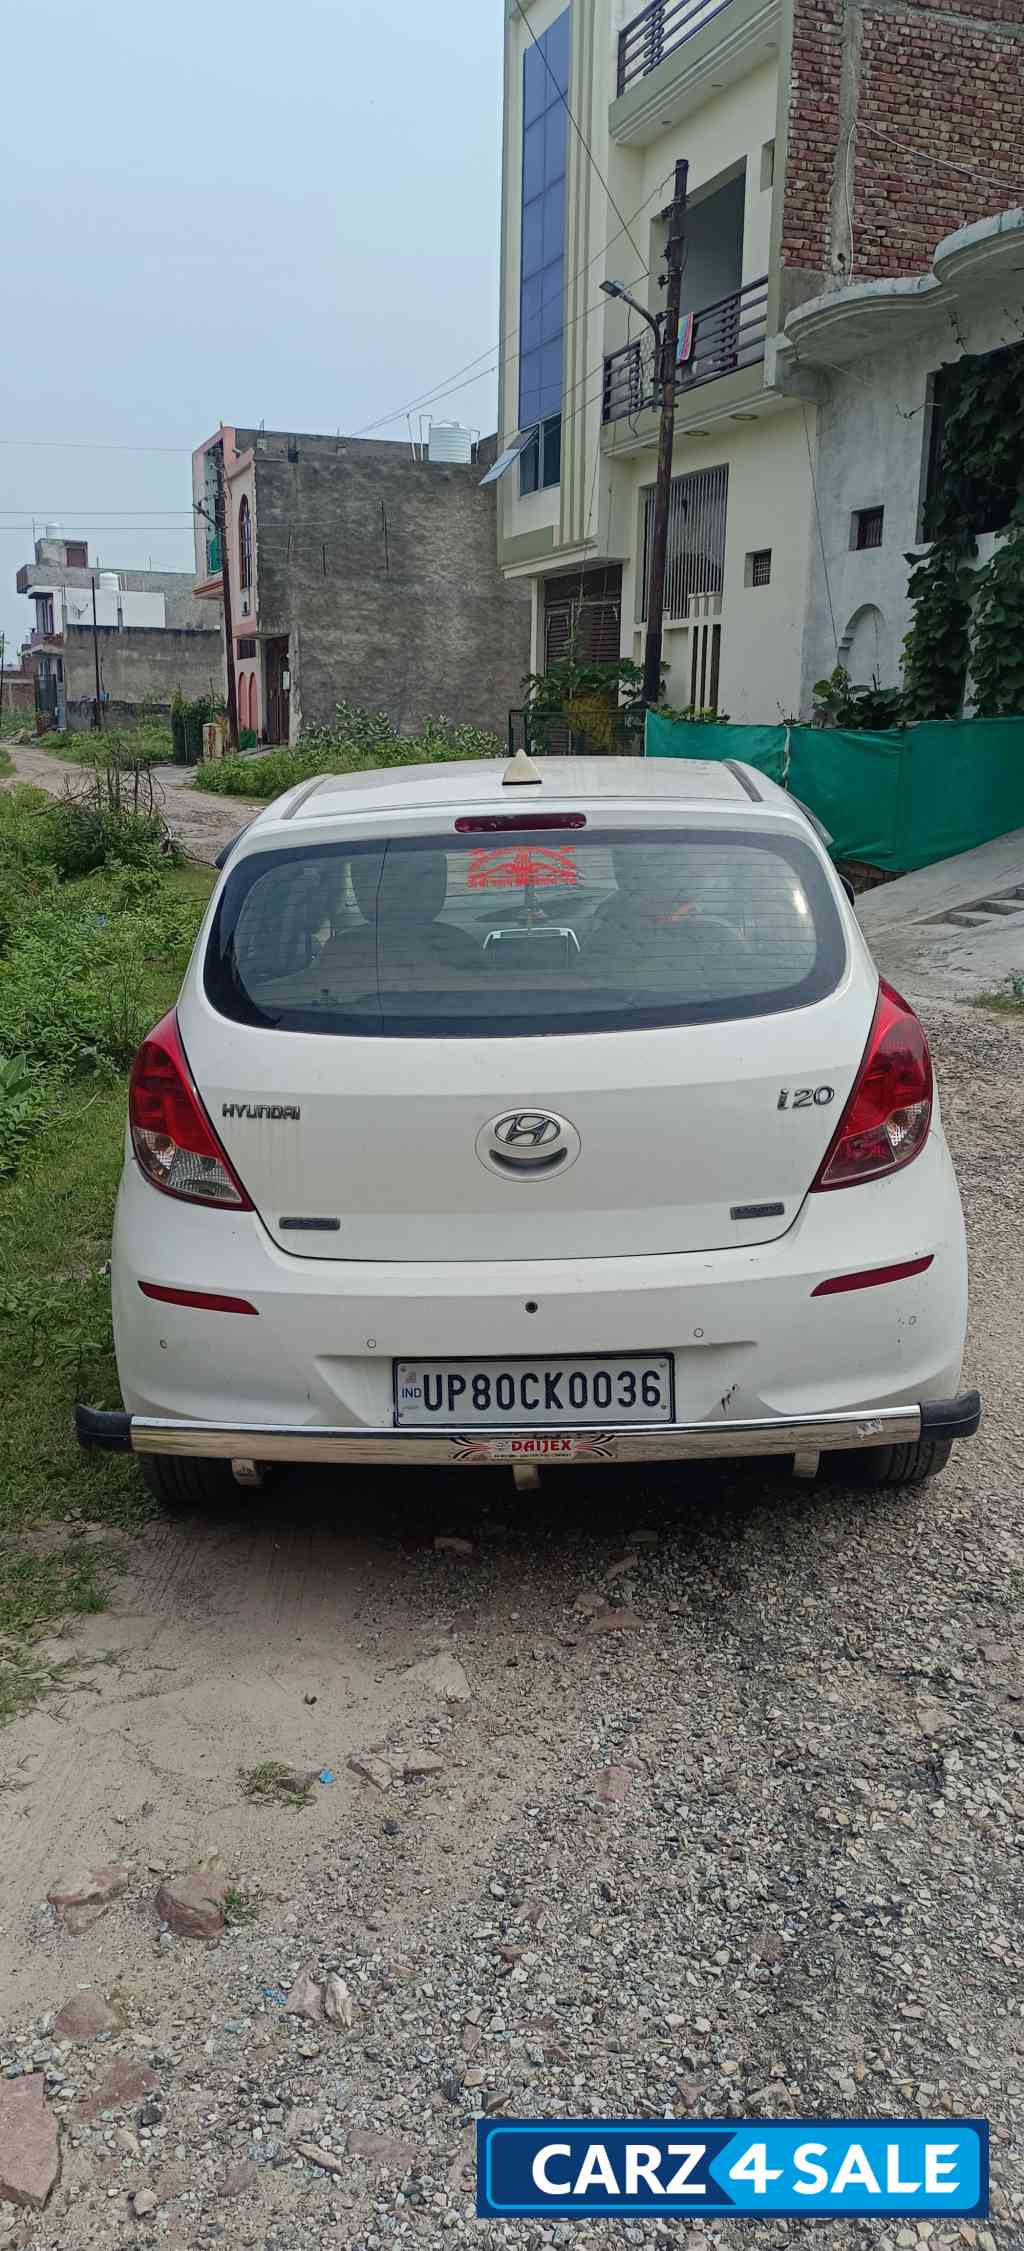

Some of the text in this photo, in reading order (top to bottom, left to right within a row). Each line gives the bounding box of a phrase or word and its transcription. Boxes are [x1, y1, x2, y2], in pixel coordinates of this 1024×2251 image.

[777, 1086, 835, 1111] i20
[222, 1103, 301, 1120] HYUNDAI
[401, 1387, 422, 1399] IND
[423, 1370, 661, 1412] UP80CK0036
[511, 1439, 572, 1453] DAIJEX
